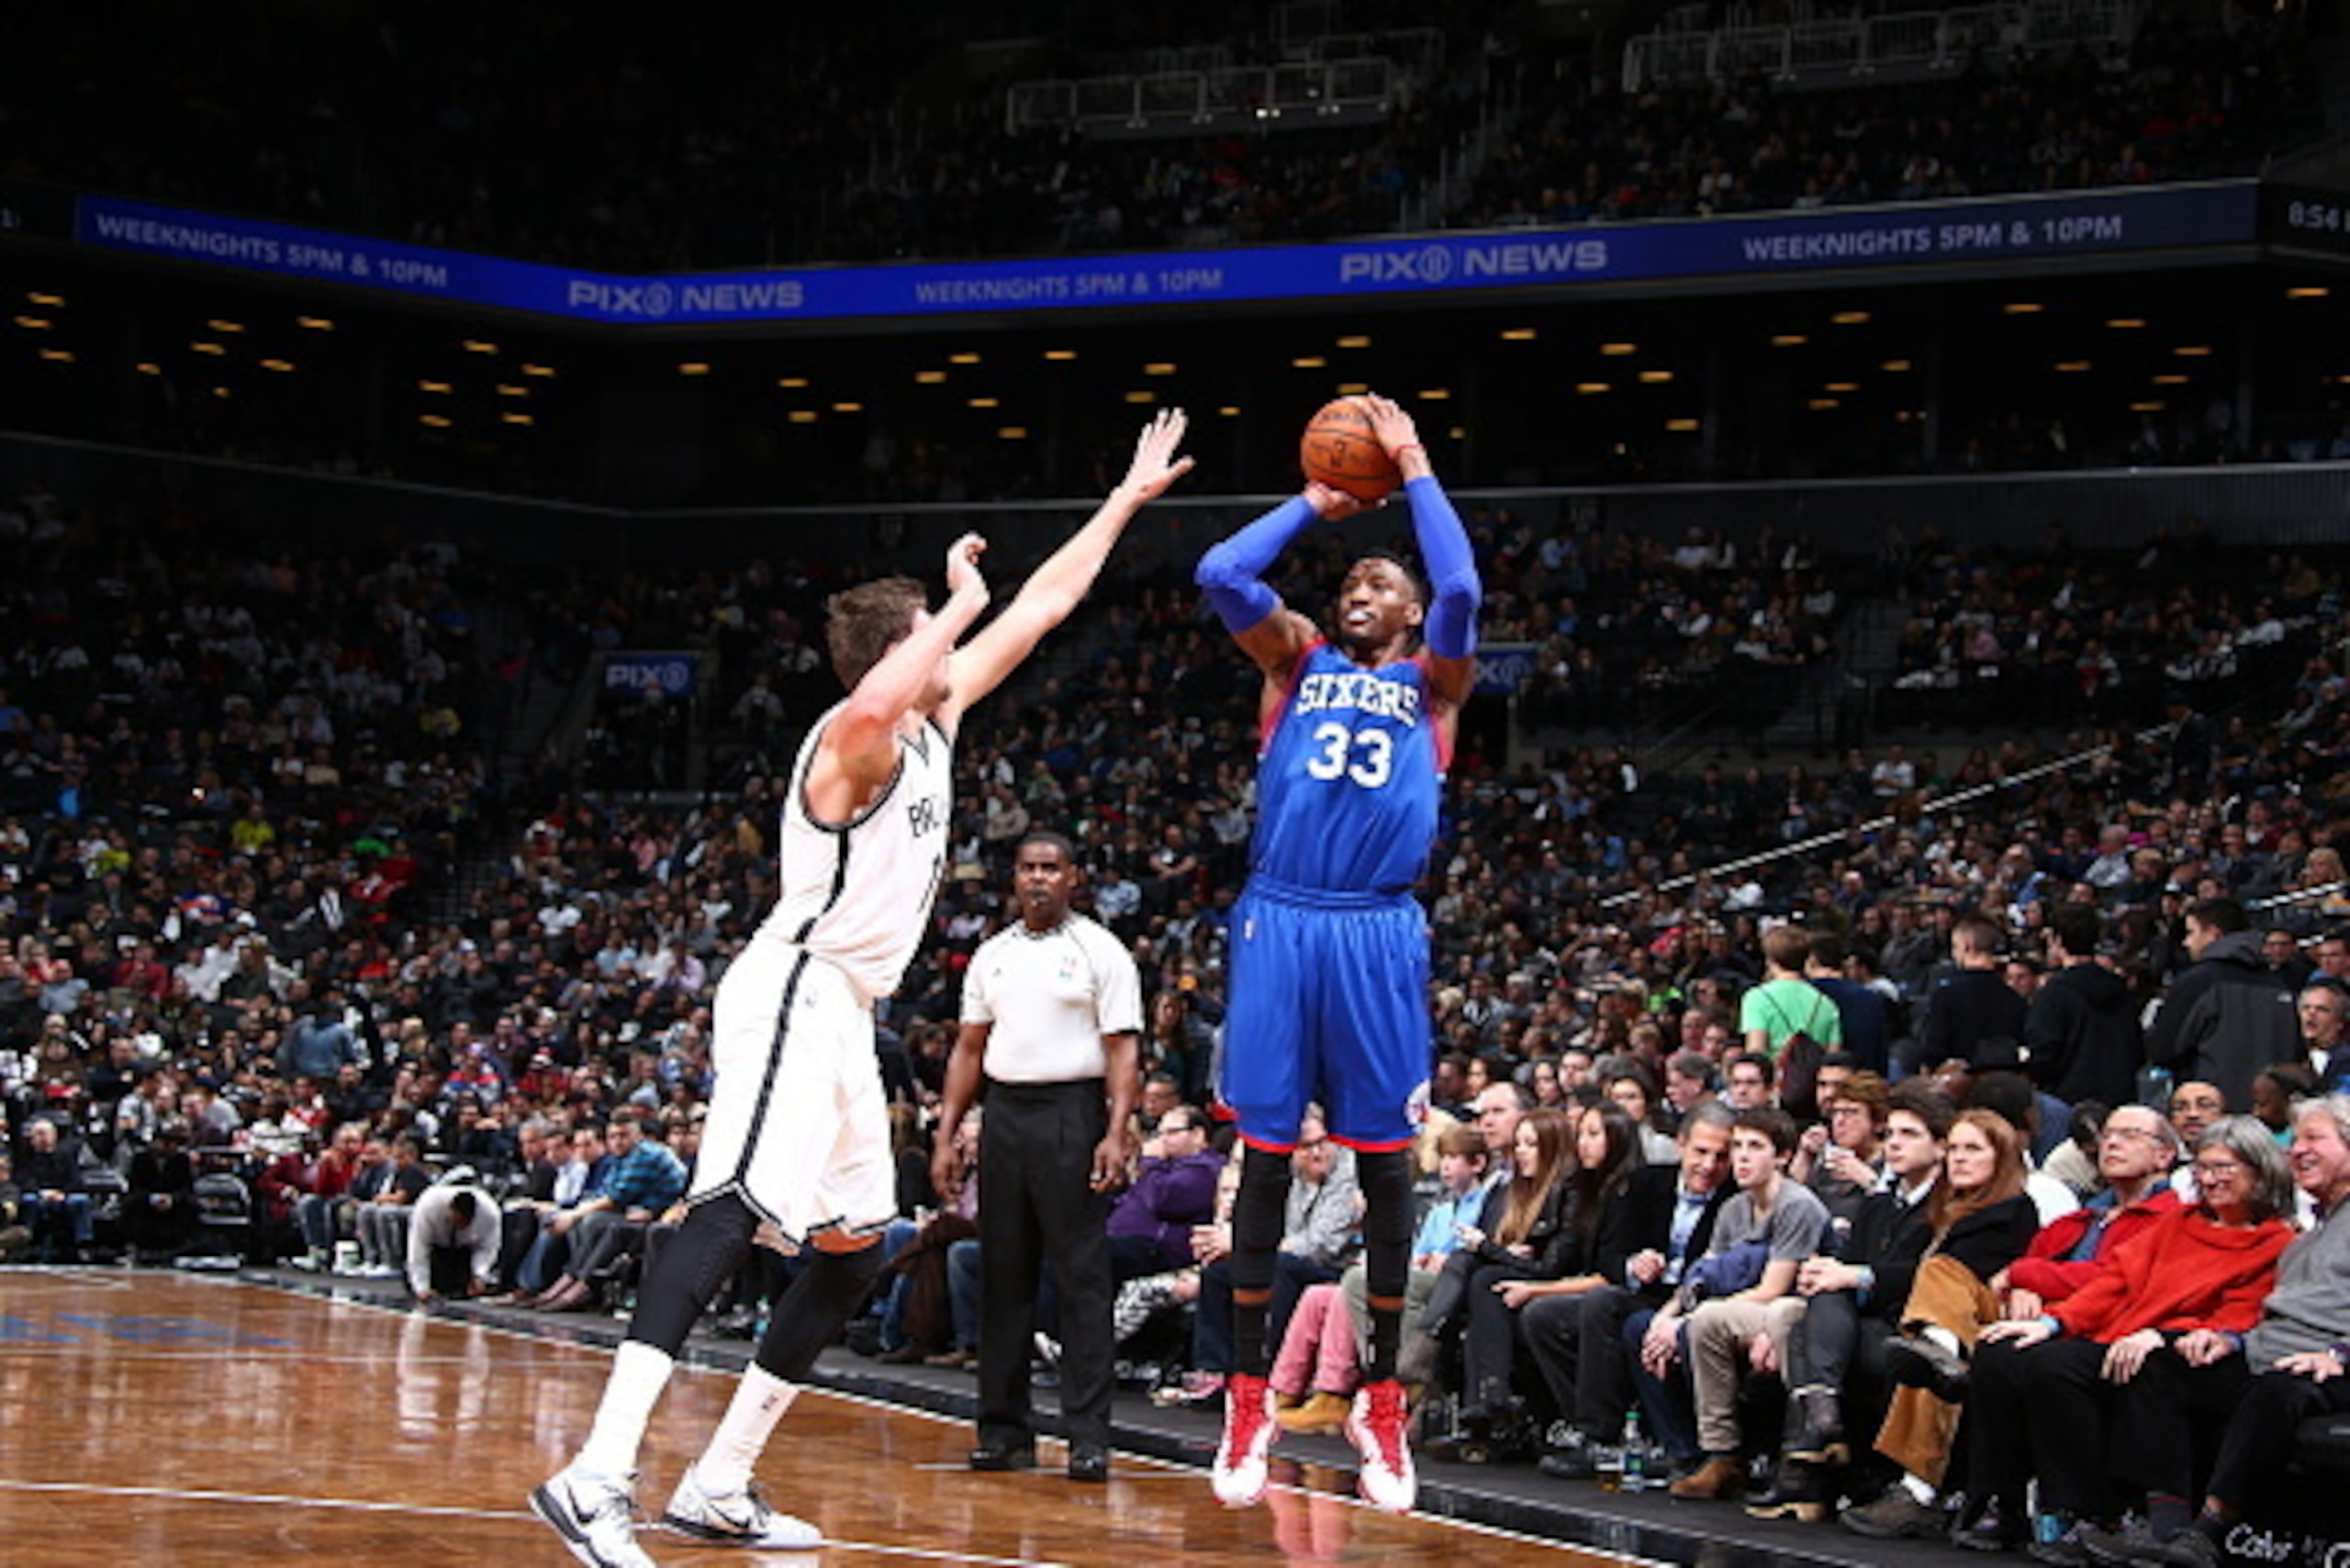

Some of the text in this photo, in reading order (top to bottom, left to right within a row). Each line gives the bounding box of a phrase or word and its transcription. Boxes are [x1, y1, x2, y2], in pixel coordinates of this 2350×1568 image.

[95, 213, 448, 288] WEEKNIGHTS 5PM & 10PM
[1463, 241, 1608, 275] NEWS
[1744, 216, 2122, 262] WEEKNIGHTS 5PM & 10PM
[681, 280, 804, 312] NEWS
[915, 268, 1225, 305] WEEKNIGHTS 5PM & 10PM
[1295, 671, 1419, 728] SIXERS
[1307, 722, 1393, 789] 33
